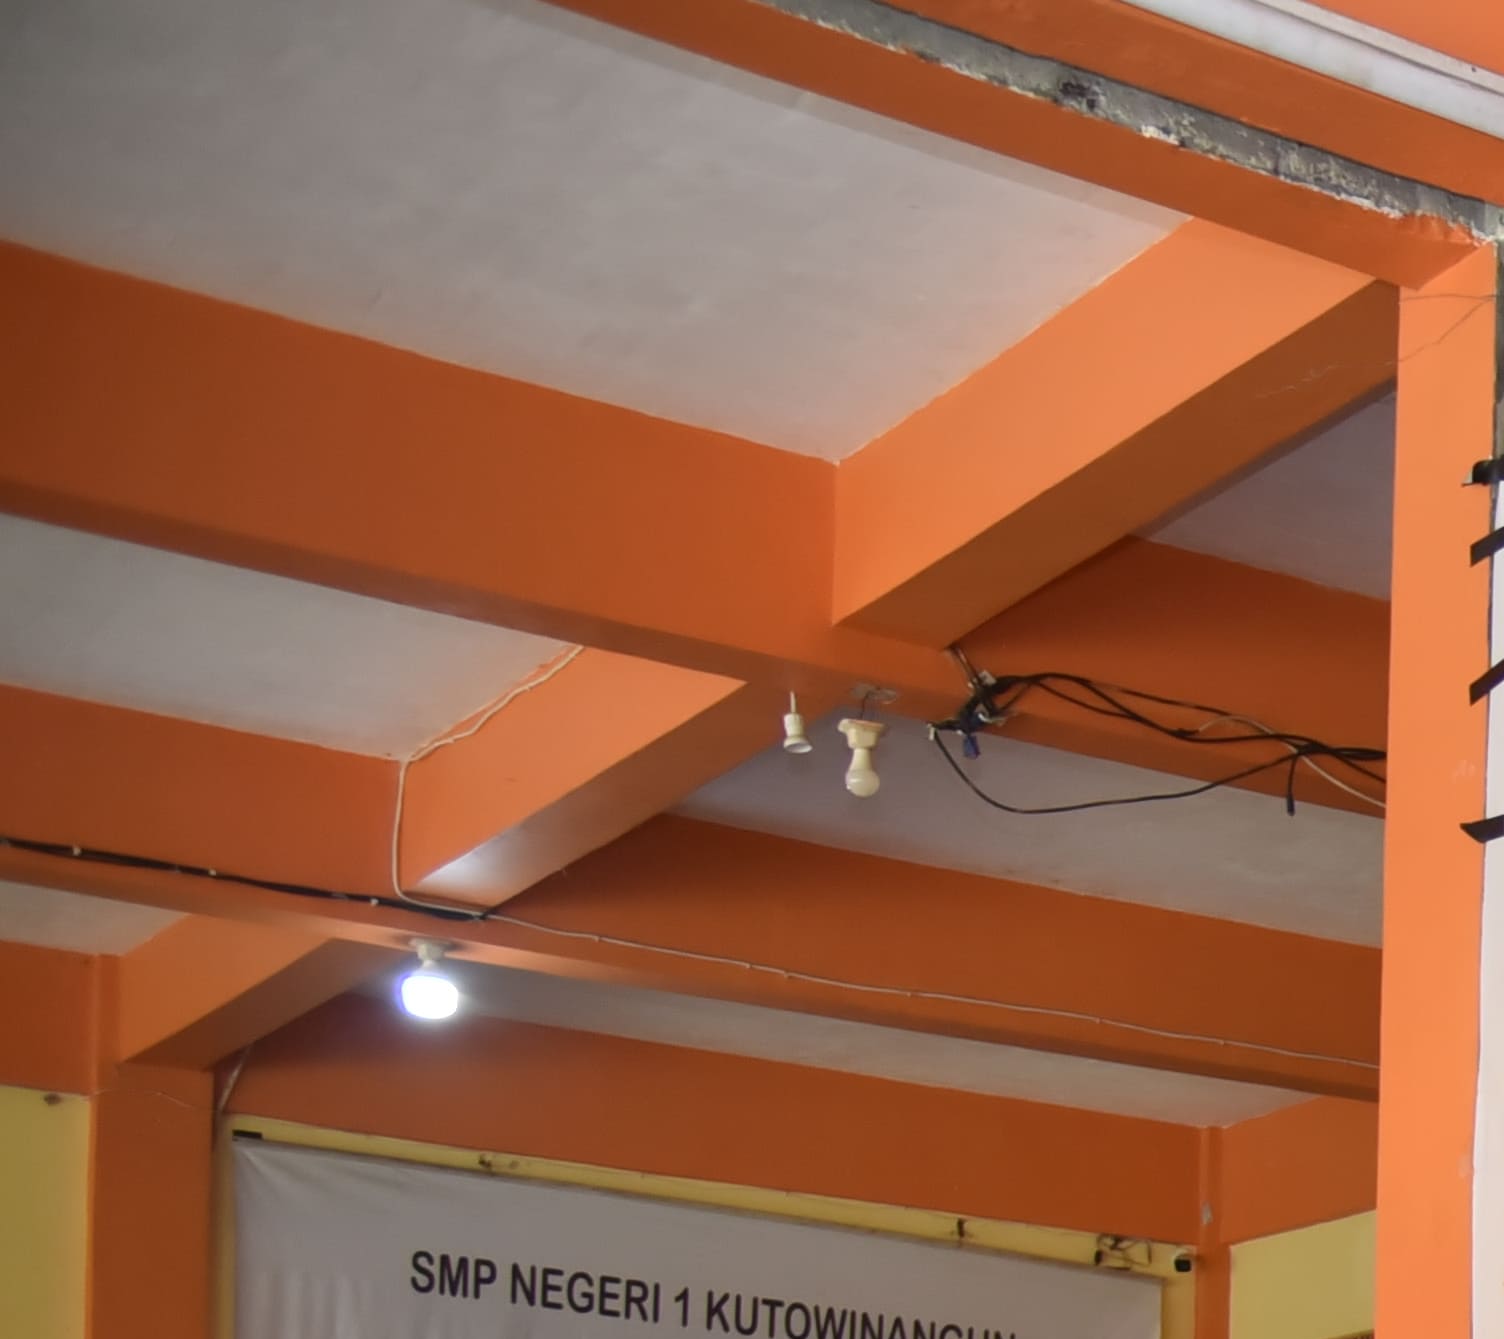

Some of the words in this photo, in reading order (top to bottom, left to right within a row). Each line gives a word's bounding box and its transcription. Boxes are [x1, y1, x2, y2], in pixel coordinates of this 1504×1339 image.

[410, 1250, 498, 1300] SMP
[510, 1262, 661, 1323] NEGERI
[674, 1286, 690, 1328] 1
